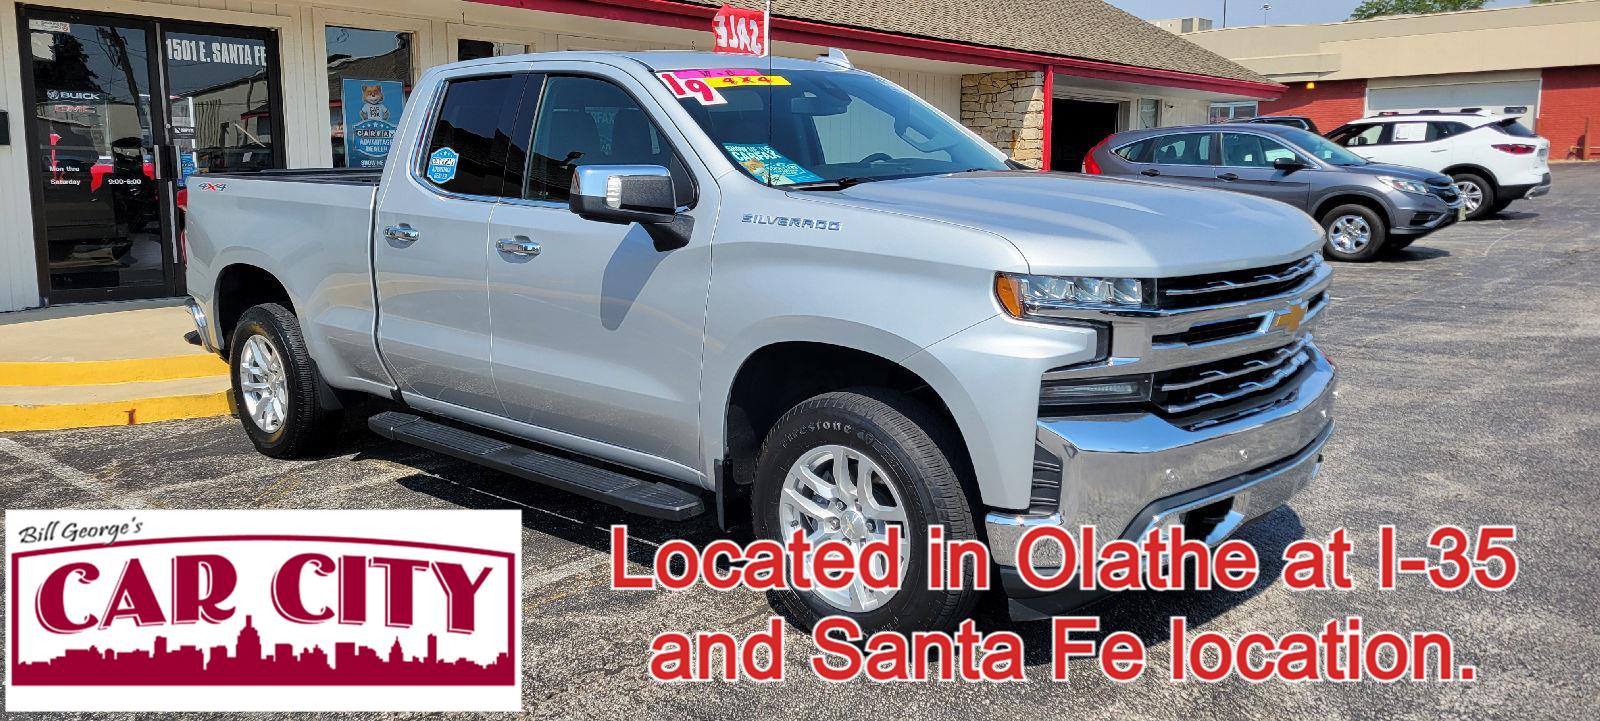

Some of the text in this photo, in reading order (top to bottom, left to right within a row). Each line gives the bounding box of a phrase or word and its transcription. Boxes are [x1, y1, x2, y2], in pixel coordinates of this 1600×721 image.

[165, 38, 267, 67] 1501 E. SANTA FE
[60, 92, 100, 100] BUICK
[661, 73, 714, 102] 19
[50, 178, 81, 186] Saturday
[741, 213, 841, 231] SILVERADO
